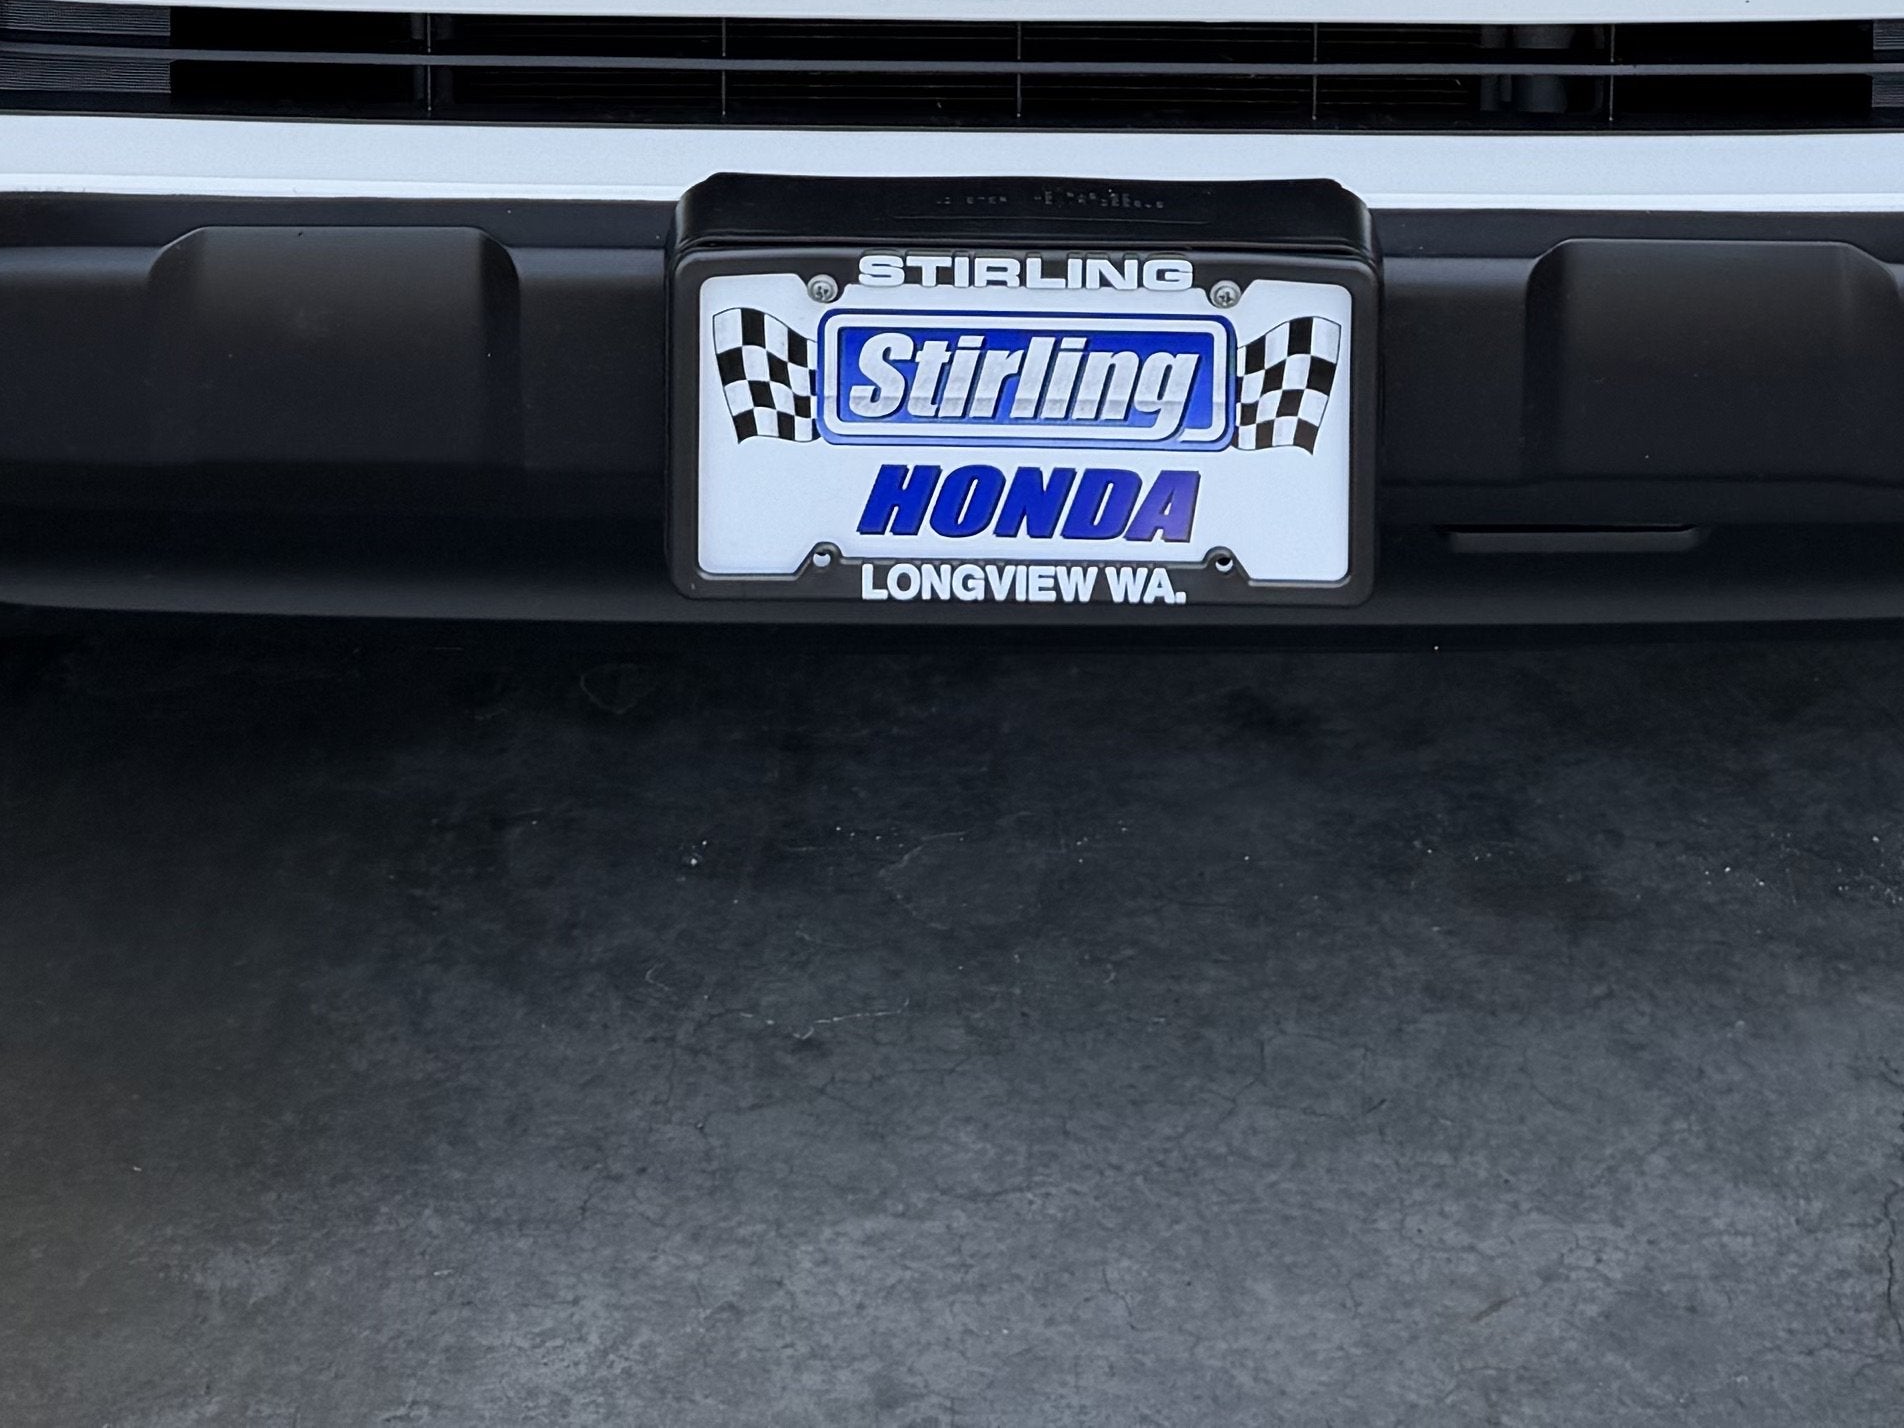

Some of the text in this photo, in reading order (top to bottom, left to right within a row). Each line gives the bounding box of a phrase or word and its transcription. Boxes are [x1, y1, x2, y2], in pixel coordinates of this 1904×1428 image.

[858, 255, 1194, 291] STIRLING
[848, 331, 1199, 440] Stirling
[856, 464, 1202, 543] HONDA
[861, 564, 1187, 604] LONGVIEW WA.
